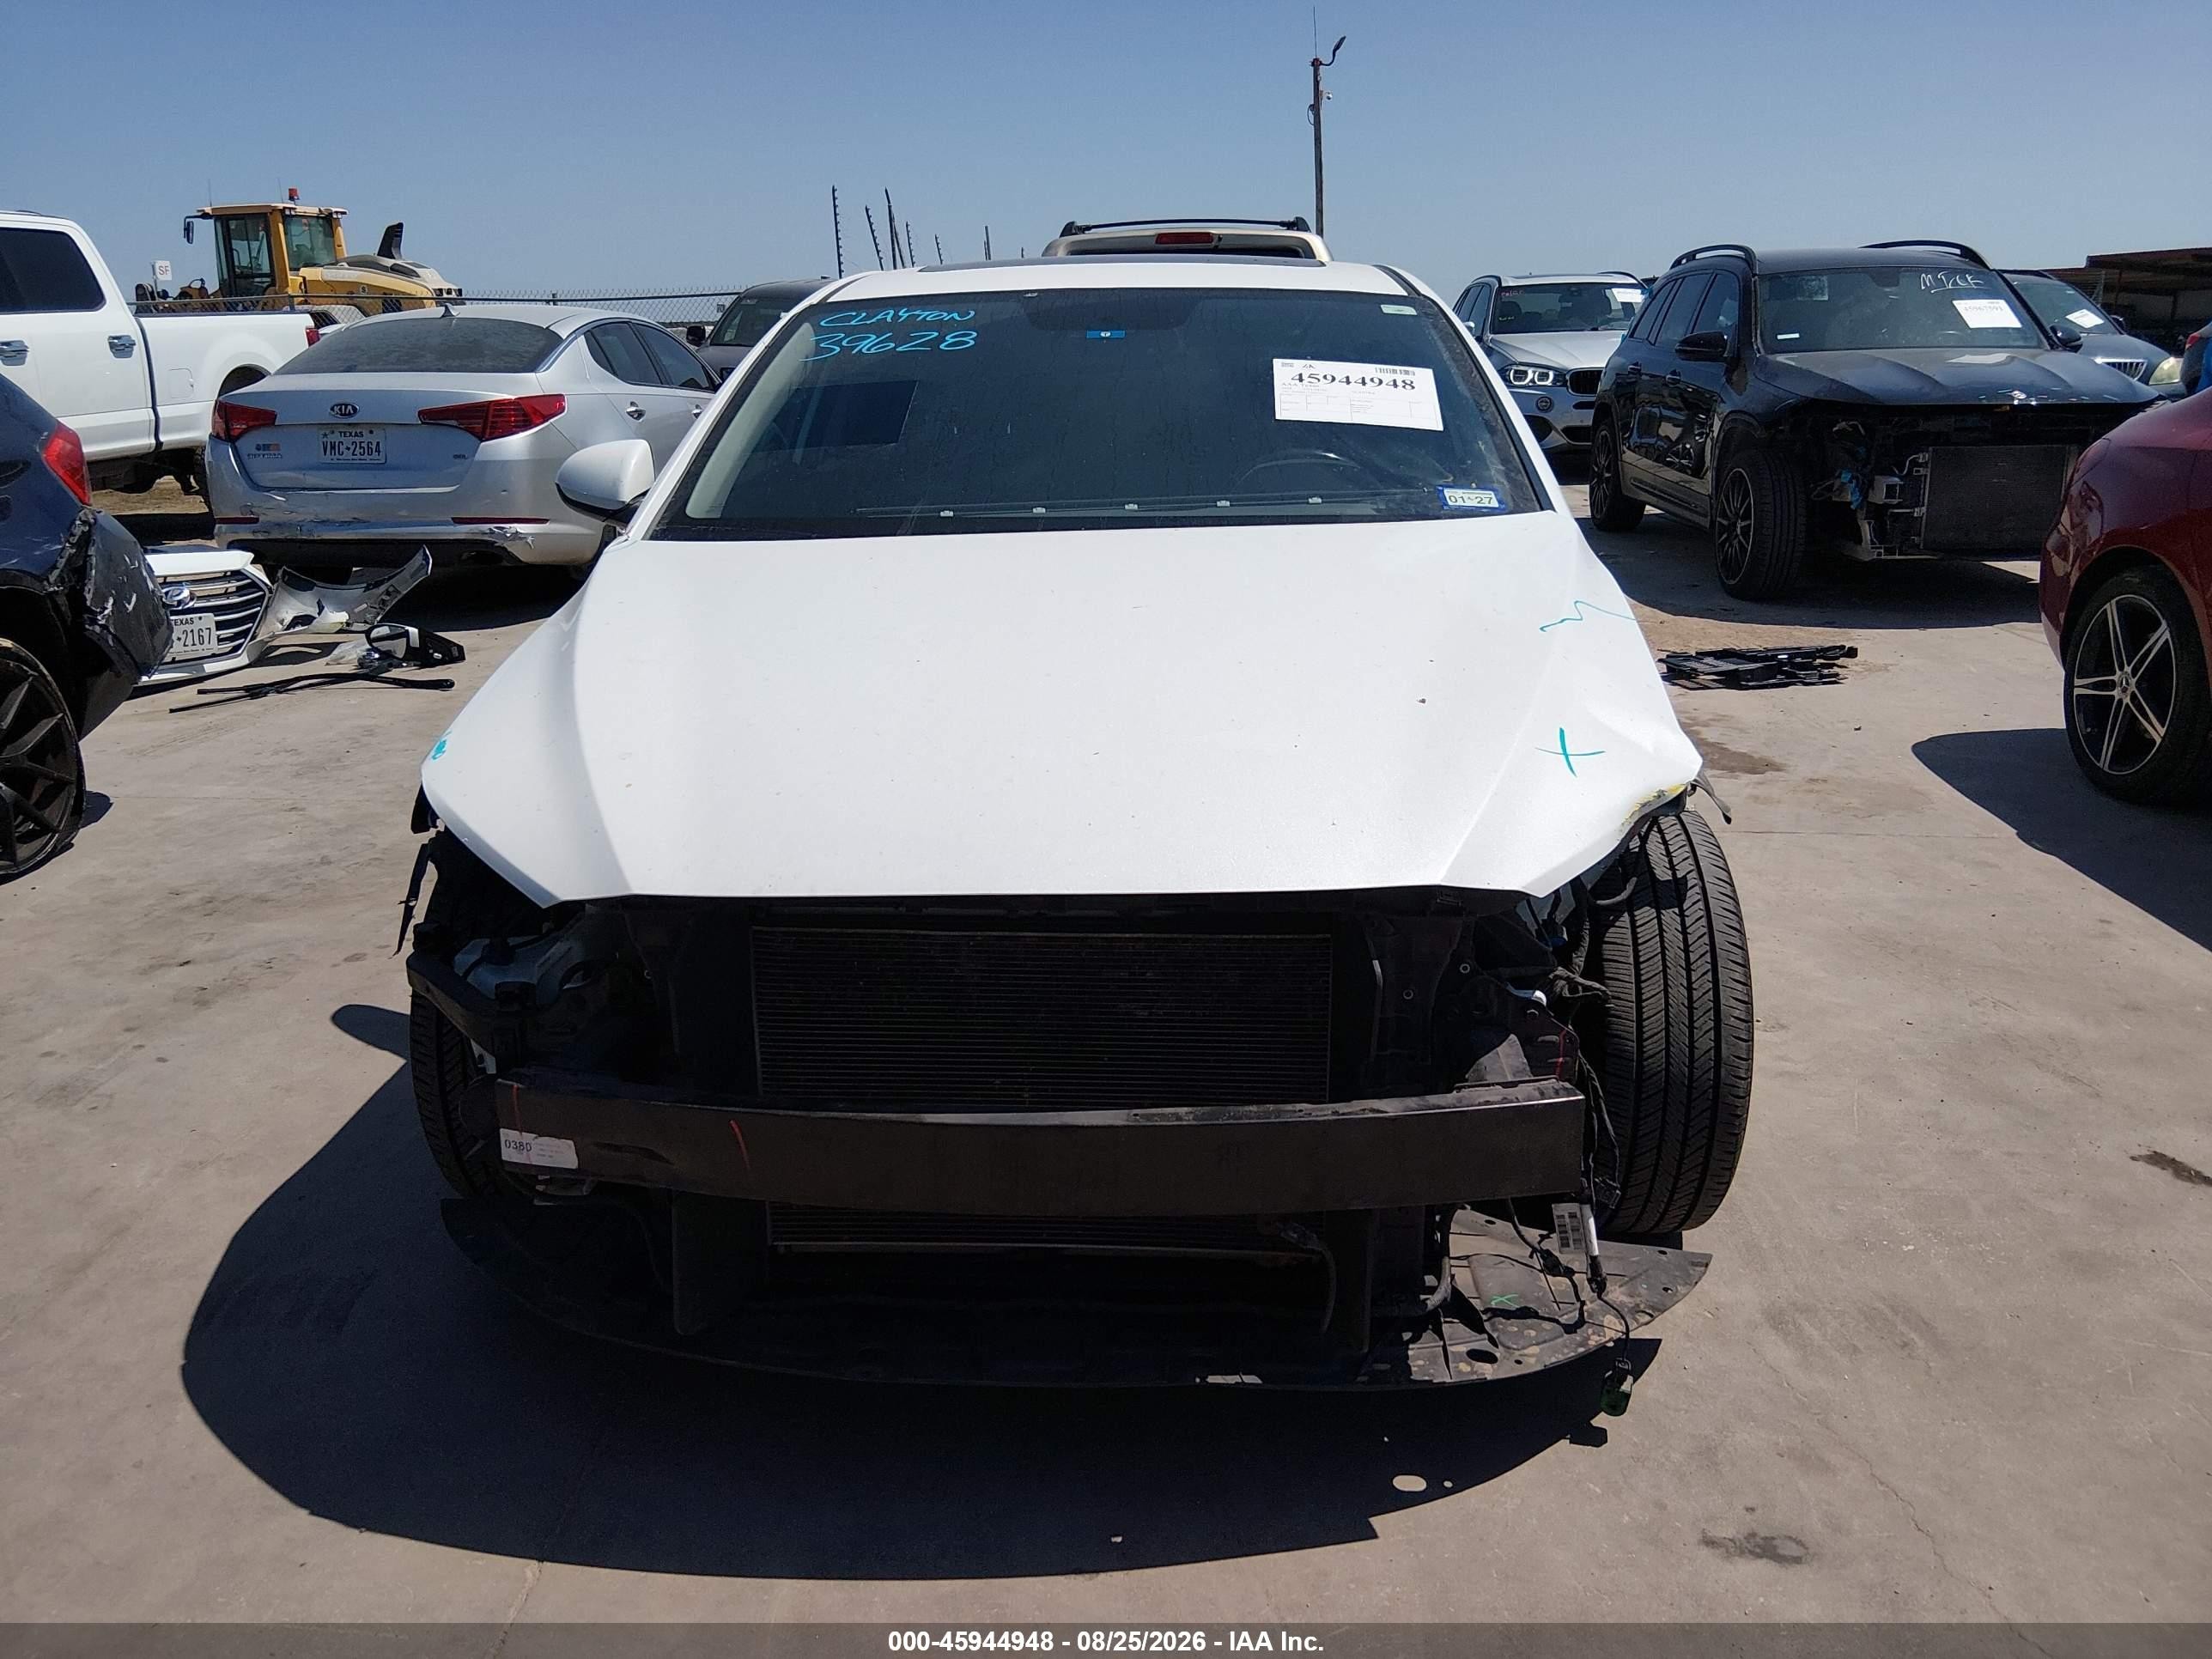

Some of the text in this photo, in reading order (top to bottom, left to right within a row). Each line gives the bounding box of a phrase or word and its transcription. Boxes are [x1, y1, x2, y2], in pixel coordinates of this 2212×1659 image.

[819, 307, 975, 328] CLAYTON
[799, 331, 979, 362] 39628
[1291, 372, 1416, 391] 45944948
[333, 404, 354, 414] KIA
[351, 441, 381, 457] 2564
[182, 628, 211, 647] 2167
